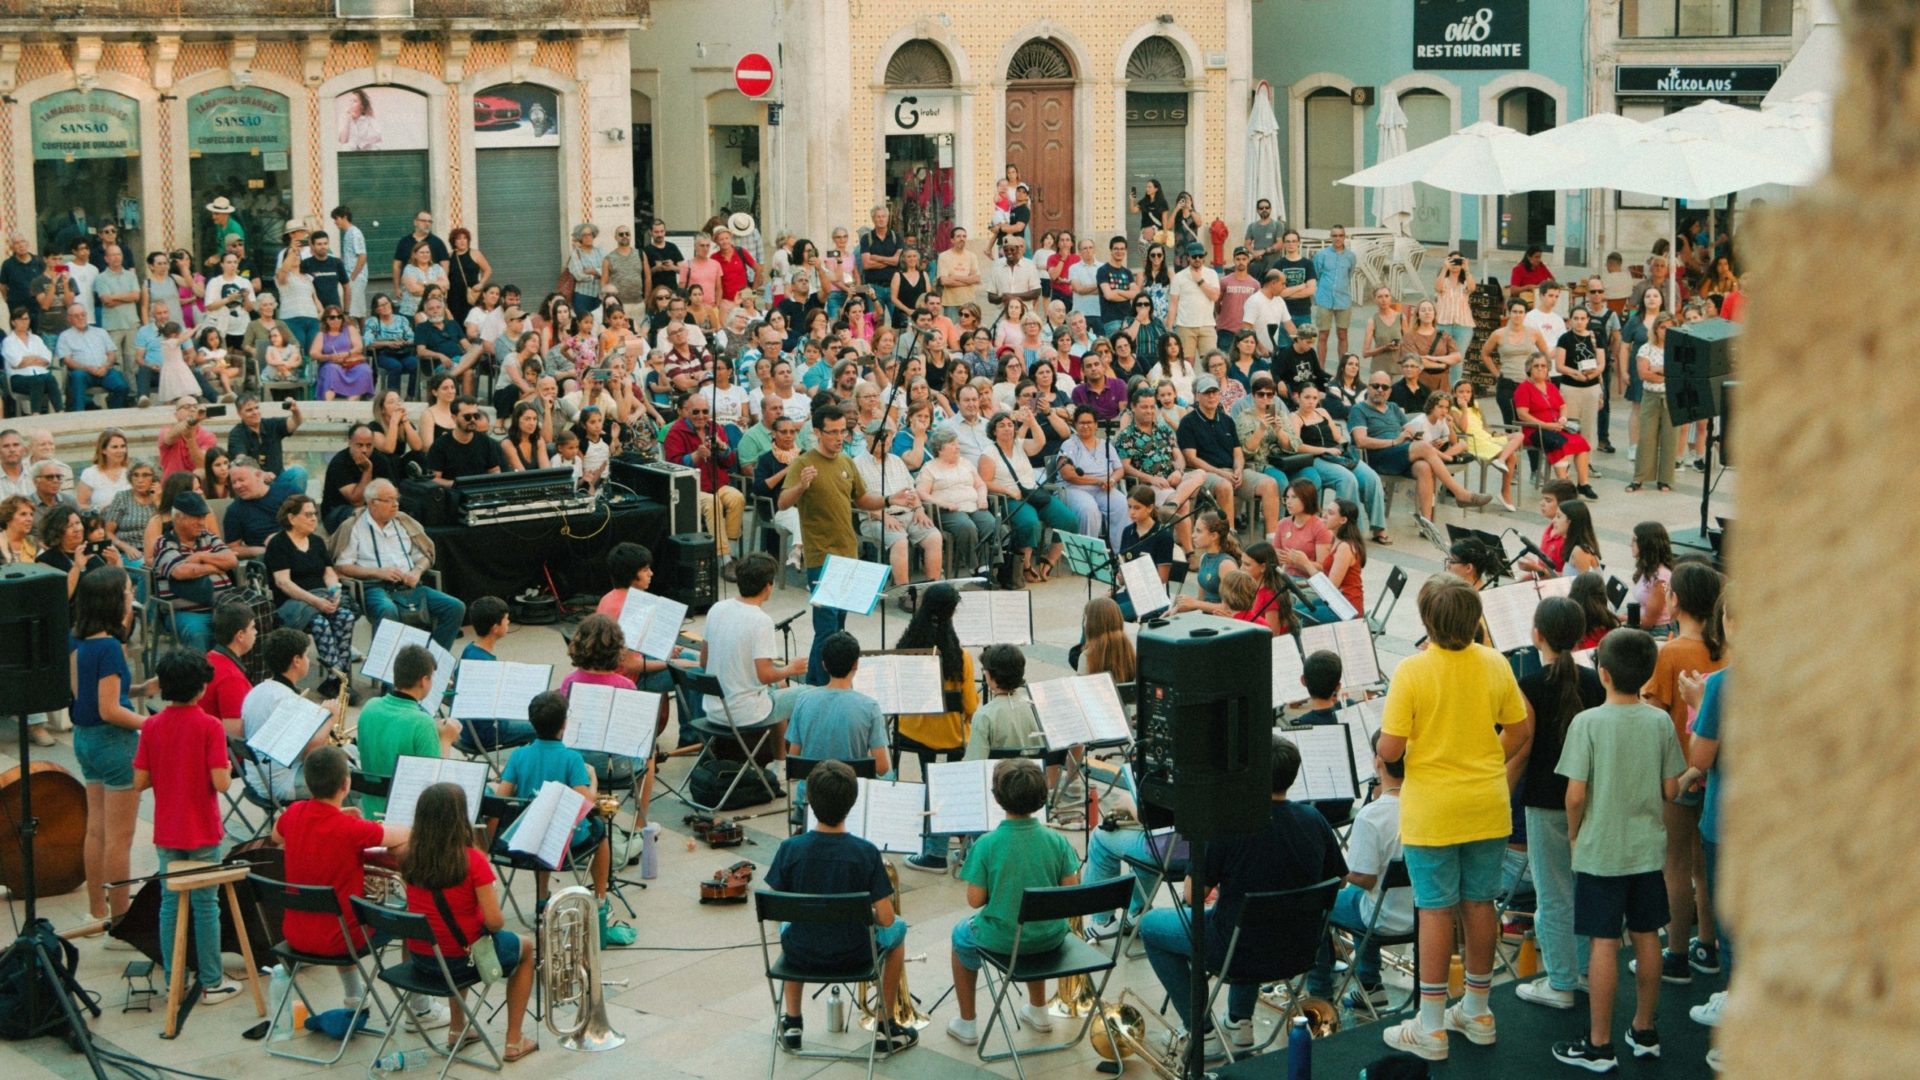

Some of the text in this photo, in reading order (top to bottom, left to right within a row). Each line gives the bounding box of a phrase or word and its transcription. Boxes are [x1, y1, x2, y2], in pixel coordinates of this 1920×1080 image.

[1417, 43, 1522, 58] RESTAURANTE
[236, 135, 244, 144] DE
[83, 140, 91, 149] DE
